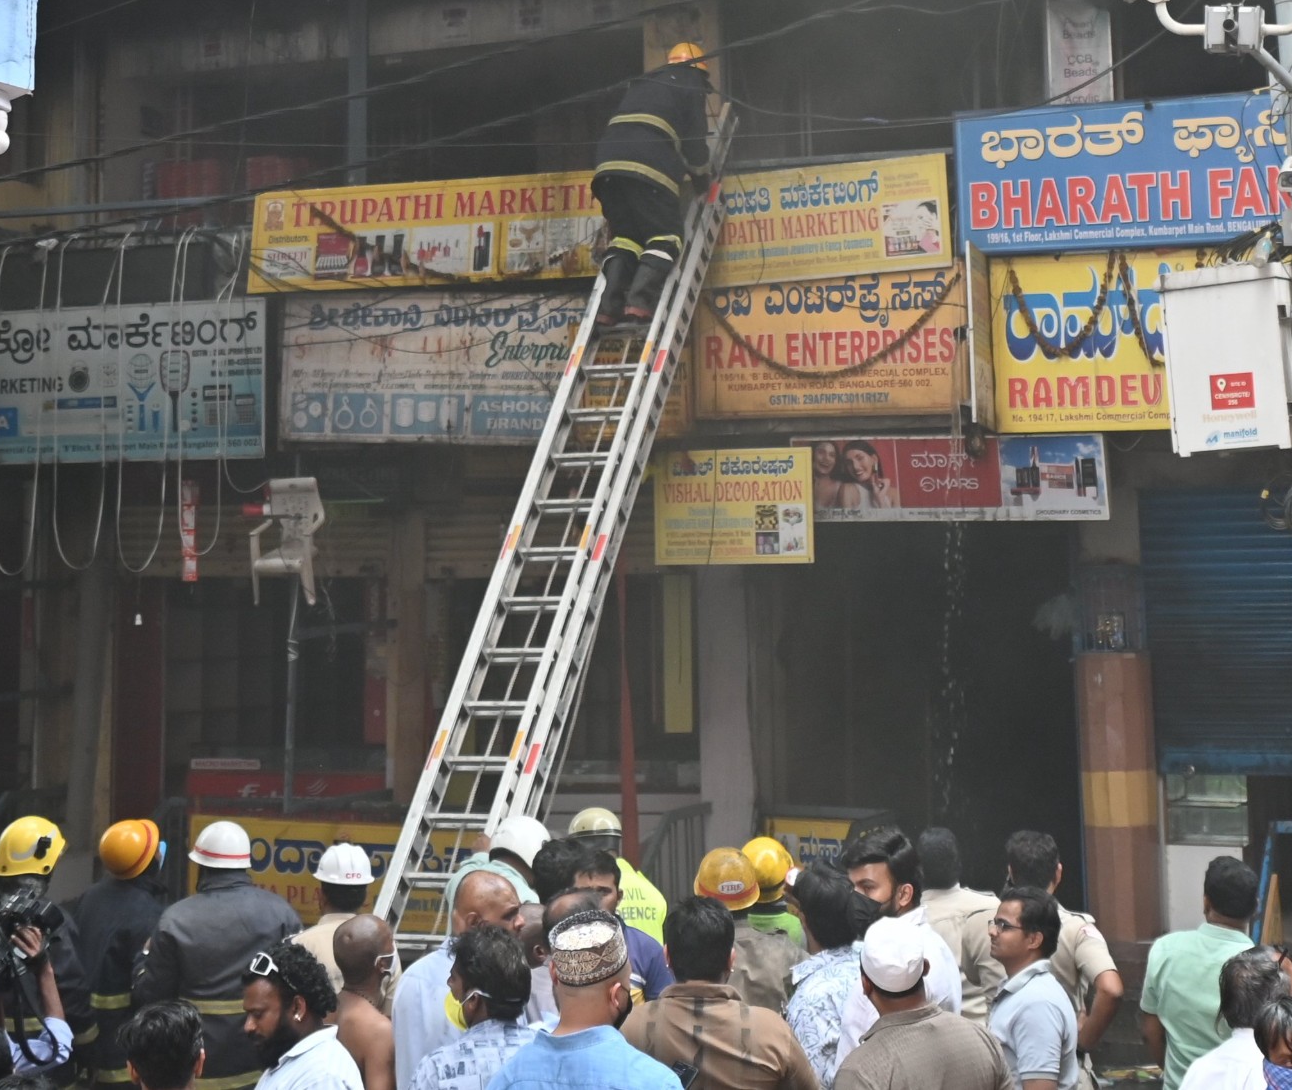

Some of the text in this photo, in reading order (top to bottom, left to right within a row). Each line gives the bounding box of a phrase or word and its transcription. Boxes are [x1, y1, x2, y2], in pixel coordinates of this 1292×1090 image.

[1068, 54, 1093, 66] CCB
[1064, 68, 1098, 78] Beads
[981, 111, 1144, 169] ಭಾರತ್
[722, 185, 771, 216] ರುಪತಿ
[780, 171, 879, 210] ಮಾರ್ಕೆಟಿಂಗ್
[970, 170, 1191, 229] BHARATH
[292, 193, 444, 228] TIRUPATHI
[781, 208, 879, 240] MARKETING
[1012, 232, 1023, 242] 1st
[1024, 231, 1043, 243] Floor,
[1045, 229, 1072, 241] Lakshmi
[1074, 228, 1114, 240] Commercial
[1148, 224, 1186, 237] Kumbarpet
[1188, 223, 1205, 234] Main
[1206, 222, 1226, 235] Road,
[68, 311, 258, 351] ಮಾರ್ಕೆಟಿಂಗ್
[705, 327, 955, 369] RAVI ENTERPRISES
[902, 367, 949, 378] COMPLEX,
[728, 383, 782, 392] KUMBARPET
[784, 382, 807, 391] MAIN
[809, 381, 837, 391] ROAD,
[915, 378, 933, 388] 002.
[1007, 374, 1163, 409] RAMDEV
[769, 394, 801, 405] GSTIN:
[1059, 413, 1094, 421] Lakshmi
[1096, 412, 1146, 421] Commercial
[1148, 411, 1171, 421] Comp
[1202, 411, 1258, 424] Honeywell
[1224, 426, 1258, 440] manifold
[138, 443, 157, 451] Main
[936, 476, 979, 490] MARS
[663, 479, 803, 504] VISHAL DECORATION
[720, 882, 743, 892] FIRE
